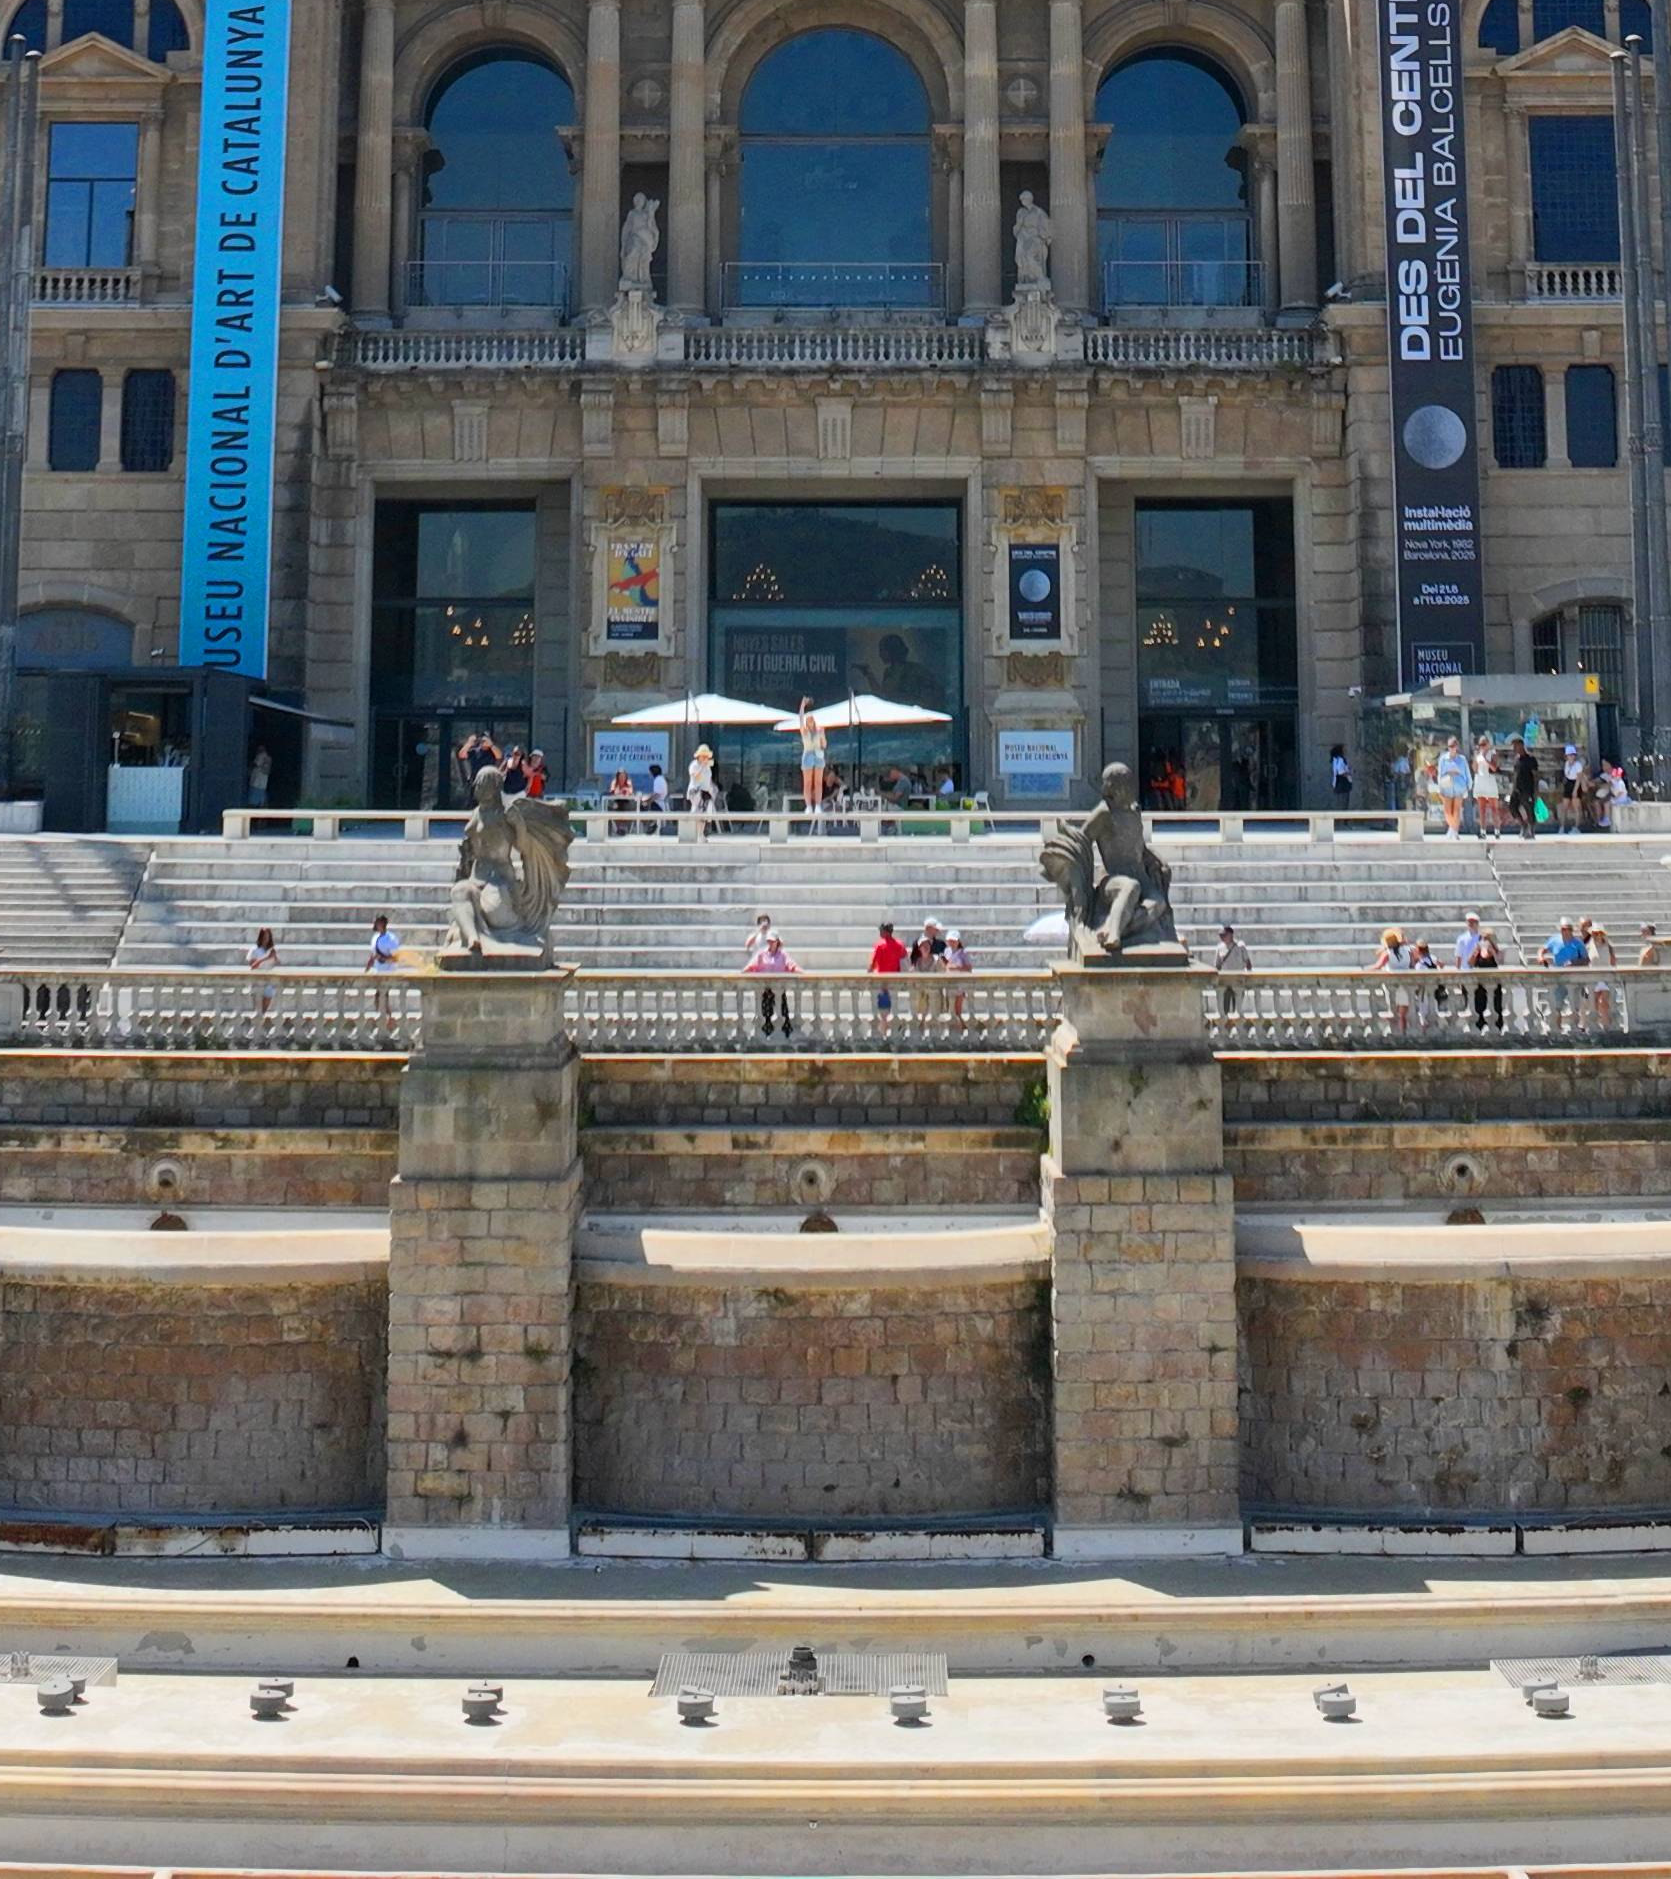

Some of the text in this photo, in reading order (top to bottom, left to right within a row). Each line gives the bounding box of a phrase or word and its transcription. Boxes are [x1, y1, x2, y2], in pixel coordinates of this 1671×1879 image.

[1427, 2, 1464, 361] EUGÈNIA BALCELLS
[1394, 152, 1427, 243] DEL
[1397, 259, 1431, 361] DES
[203, 5, 265, 667] USEU NACIONAL D'ART DE CATALUNYA
[1404, 539, 1428, 549] Nova
[1421, 583, 1438, 594] Del
[771, 633, 805, 652] SALES
[732, 654, 755, 673] ART
[763, 654, 807, 673] GUERRA
[809, 654, 839, 674] CIVIL
[1417, 648, 1448, 662] MUSEU
[1418, 661, 1463, 675] NACIONAL
